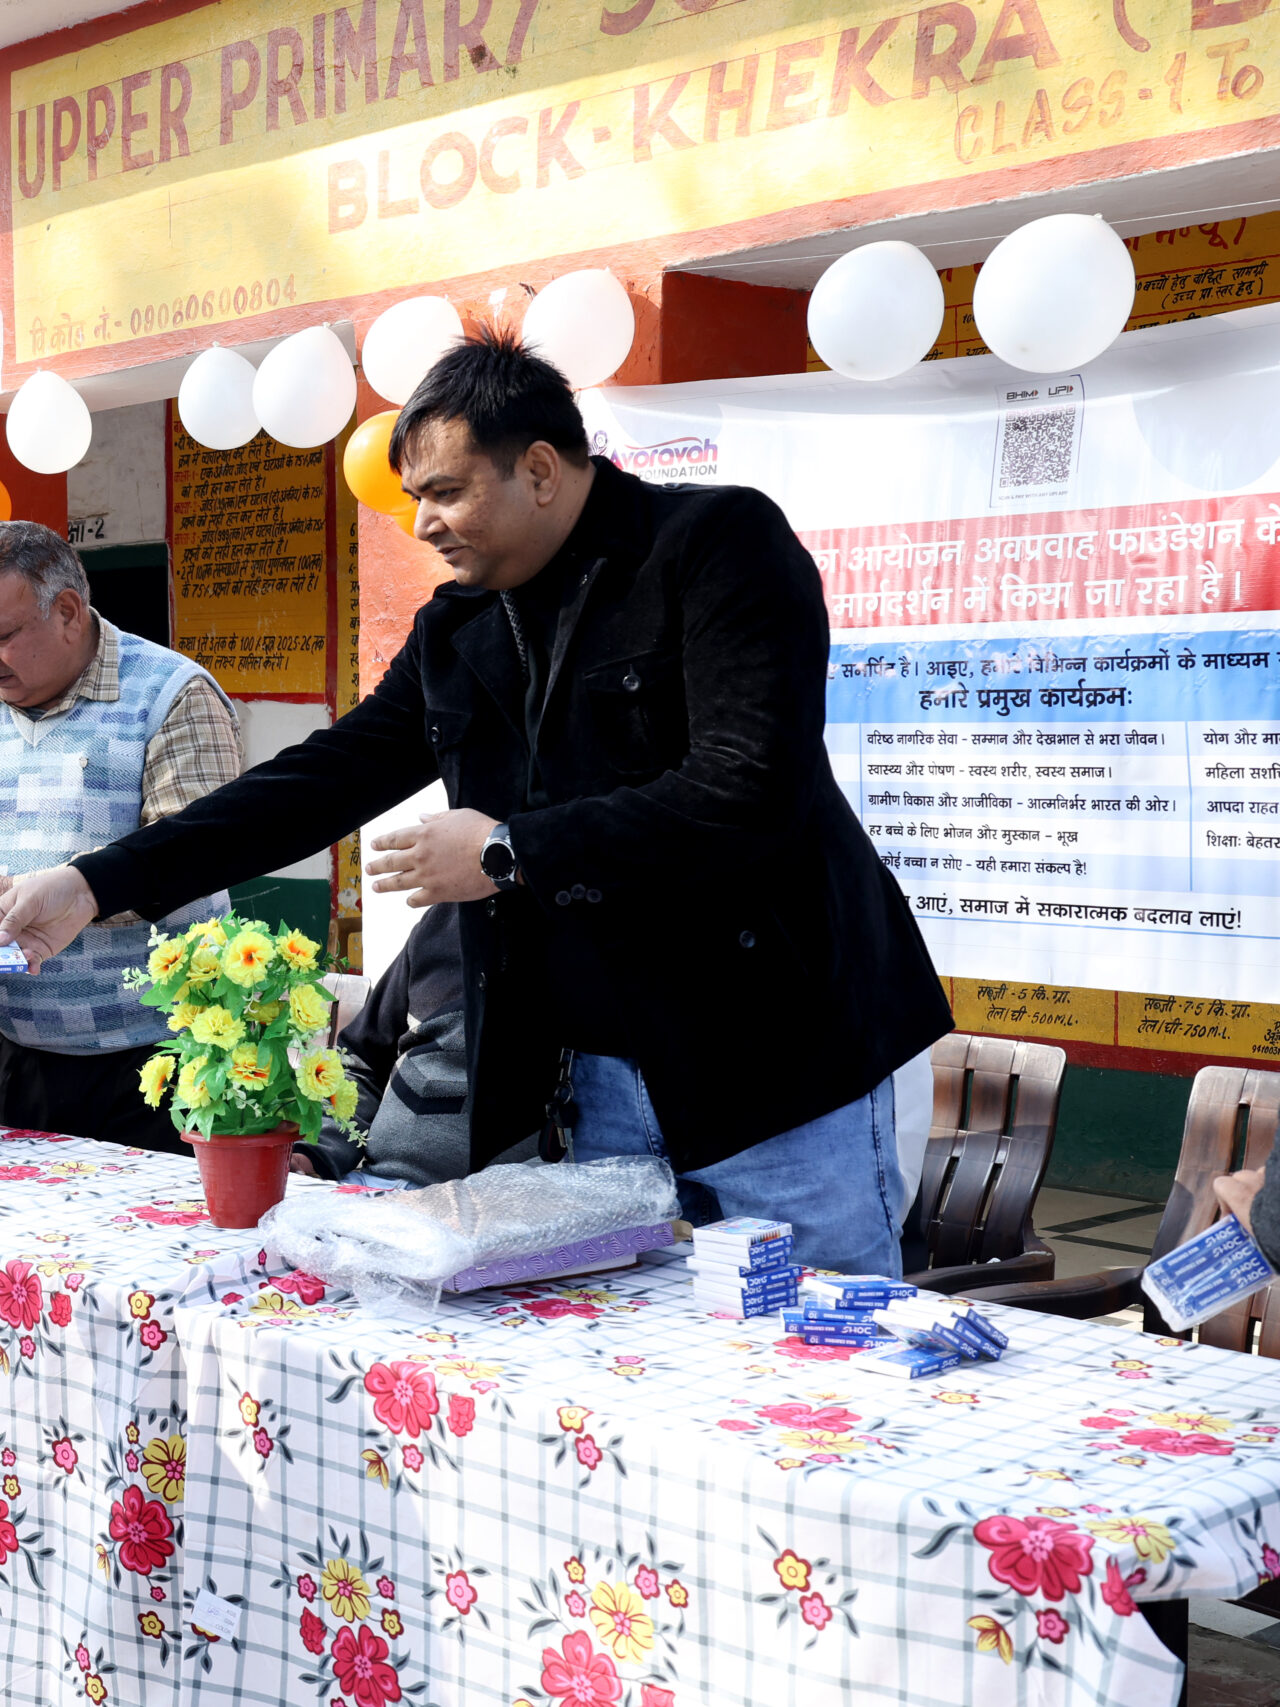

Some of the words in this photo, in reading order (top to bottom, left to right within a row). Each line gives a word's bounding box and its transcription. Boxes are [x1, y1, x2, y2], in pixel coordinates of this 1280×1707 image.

[18, 61, 192, 199] UPPER
[1006, 391, 1036, 400] BHIM
[1048, 386, 1072, 396] UPI
[848, 533, 965, 571] आयोजन
[974, 531, 1098, 564] अवप्रवाह
[1107, 512, 1245, 555] फाउंडेशन
[832, 576, 953, 618] मार्गदर्शन
[963, 575, 990, 611] में
[999, 573, 1074, 611] किया
[1084, 579, 1125, 606] जा
[1135, 575, 1188, 606] रहा
[926, 660, 974, 679] आइए,
[1094, 648, 1170, 672] कार्यक्रमों
[1177, 648, 1196, 669] के
[1202, 652, 1270, 670] माध्यम
[920, 682, 969, 710] हमारे
[976, 688, 1031, 716] प्रमुख
[867, 730, 894, 745] वरिष्ठ
[896, 730, 934, 745] नागरिक
[937, 730, 958, 745] सेवा
[971, 733, 1008, 745] सम्मान
[1012, 729, 1032, 745] और
[1036, 729, 1080, 746] देखभाल
[1083, 729, 1095, 746] से
[1099, 733, 1120, 746] भरा
[1203, 728, 1229, 745] योग
[1234, 728, 1258, 745] और
[905, 760, 924, 776] और
[928, 761, 955, 776] पोषण
[1035, 765, 1066, 778] स्वस्थ
[1205, 762, 1245, 780] महिला
[868, 791, 900, 806] ग्रामीण
[903, 791, 934, 807] विकास
[937, 791, 958, 807] और
[961, 793, 1012, 809] आजीविका
[1027, 794, 1086, 810] आत्मनिर्भर
[1091, 798, 1121, 811] भारत
[1125, 795, 1140, 811] की
[1207, 800, 1244, 814] आपदा
[1248, 801, 1279, 815] राहत
[869, 824, 881, 836] हर
[885, 822, 904, 837] बच्चे
[907, 822, 917, 837] के
[920, 822, 939, 838] लिए
[943, 823, 973, 839] भोजन
[977, 823, 998, 840] और
[1002, 828, 1040, 845] मुस्कान
[1057, 830, 1078, 847] भूख
[904, 856, 927, 868] बच्चा
[930, 856, 939, 868] न
[942, 853, 962, 871] सोए
[976, 855, 997, 872] यही
[1000, 860, 1031, 873] हमारा
[1035, 858, 1071, 874] संकल्प
[959, 897, 1009, 915] समाज
[1014, 895, 1031, 916] में
[1036, 902, 1128, 922] सकारात्मक
[1133, 907, 1193, 926] बदलाव
